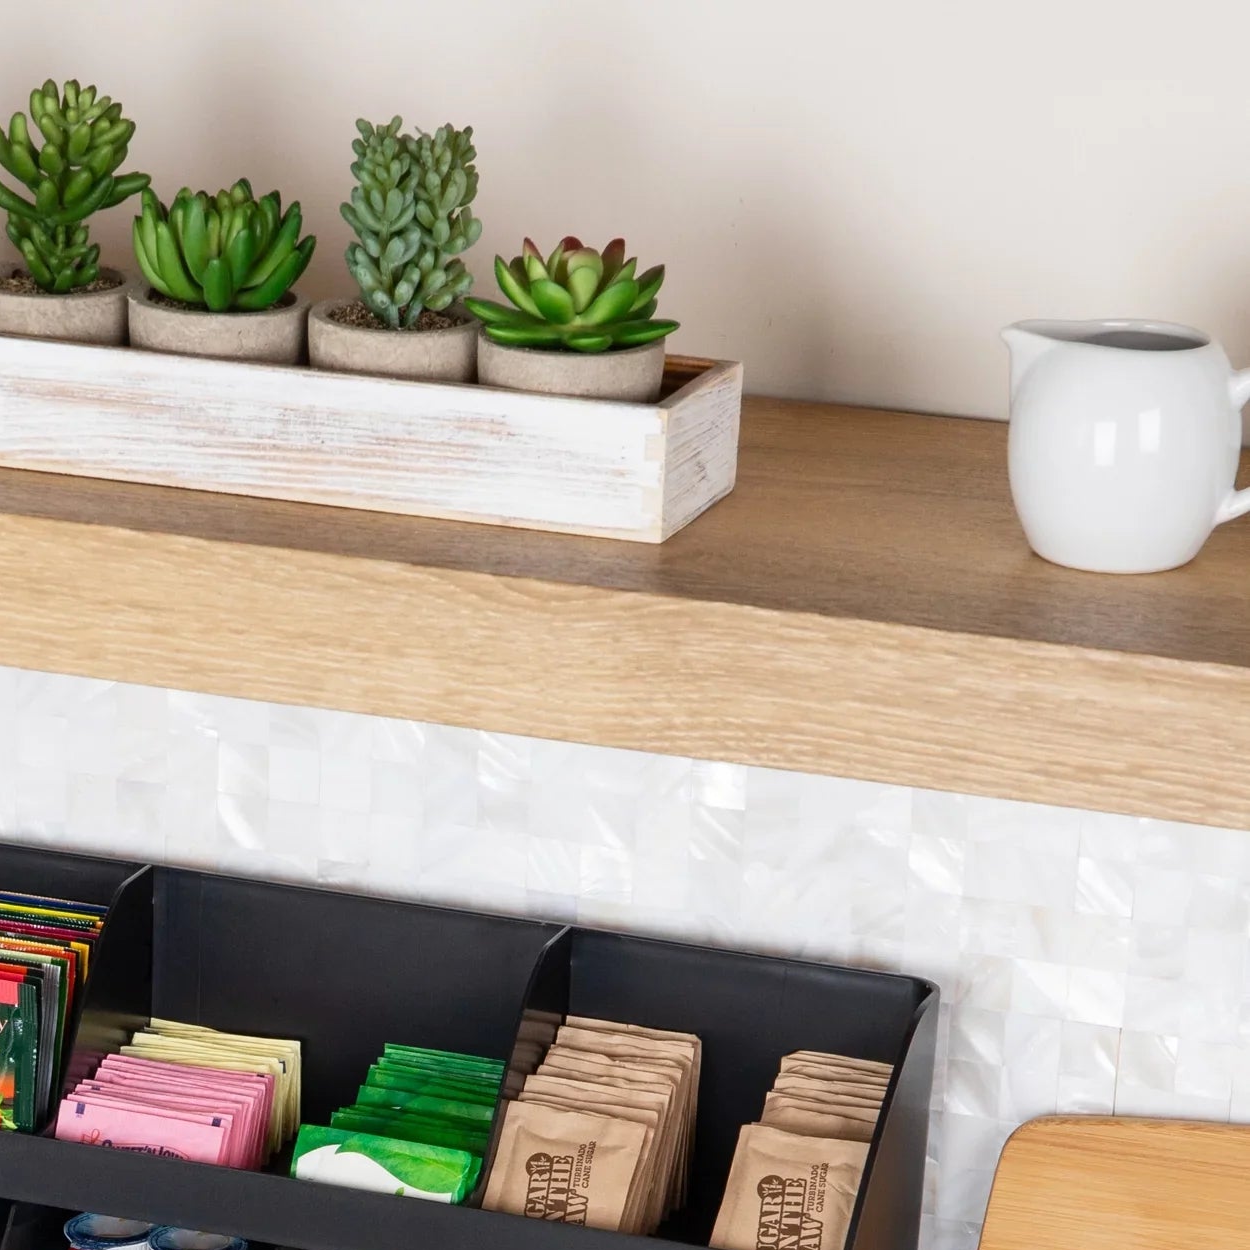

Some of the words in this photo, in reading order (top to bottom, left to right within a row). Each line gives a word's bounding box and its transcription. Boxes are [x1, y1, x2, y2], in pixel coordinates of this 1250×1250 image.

[573, 1143, 588, 1187] TURBINADO
[582, 1165, 592, 1189] CANE
[588, 1141, 597, 1164] SUGAR
[820, 1162, 829, 1188] SUGAR
[807, 1164, 820, 1212] TURBINADO
[816, 1188, 826, 1213] CANE
